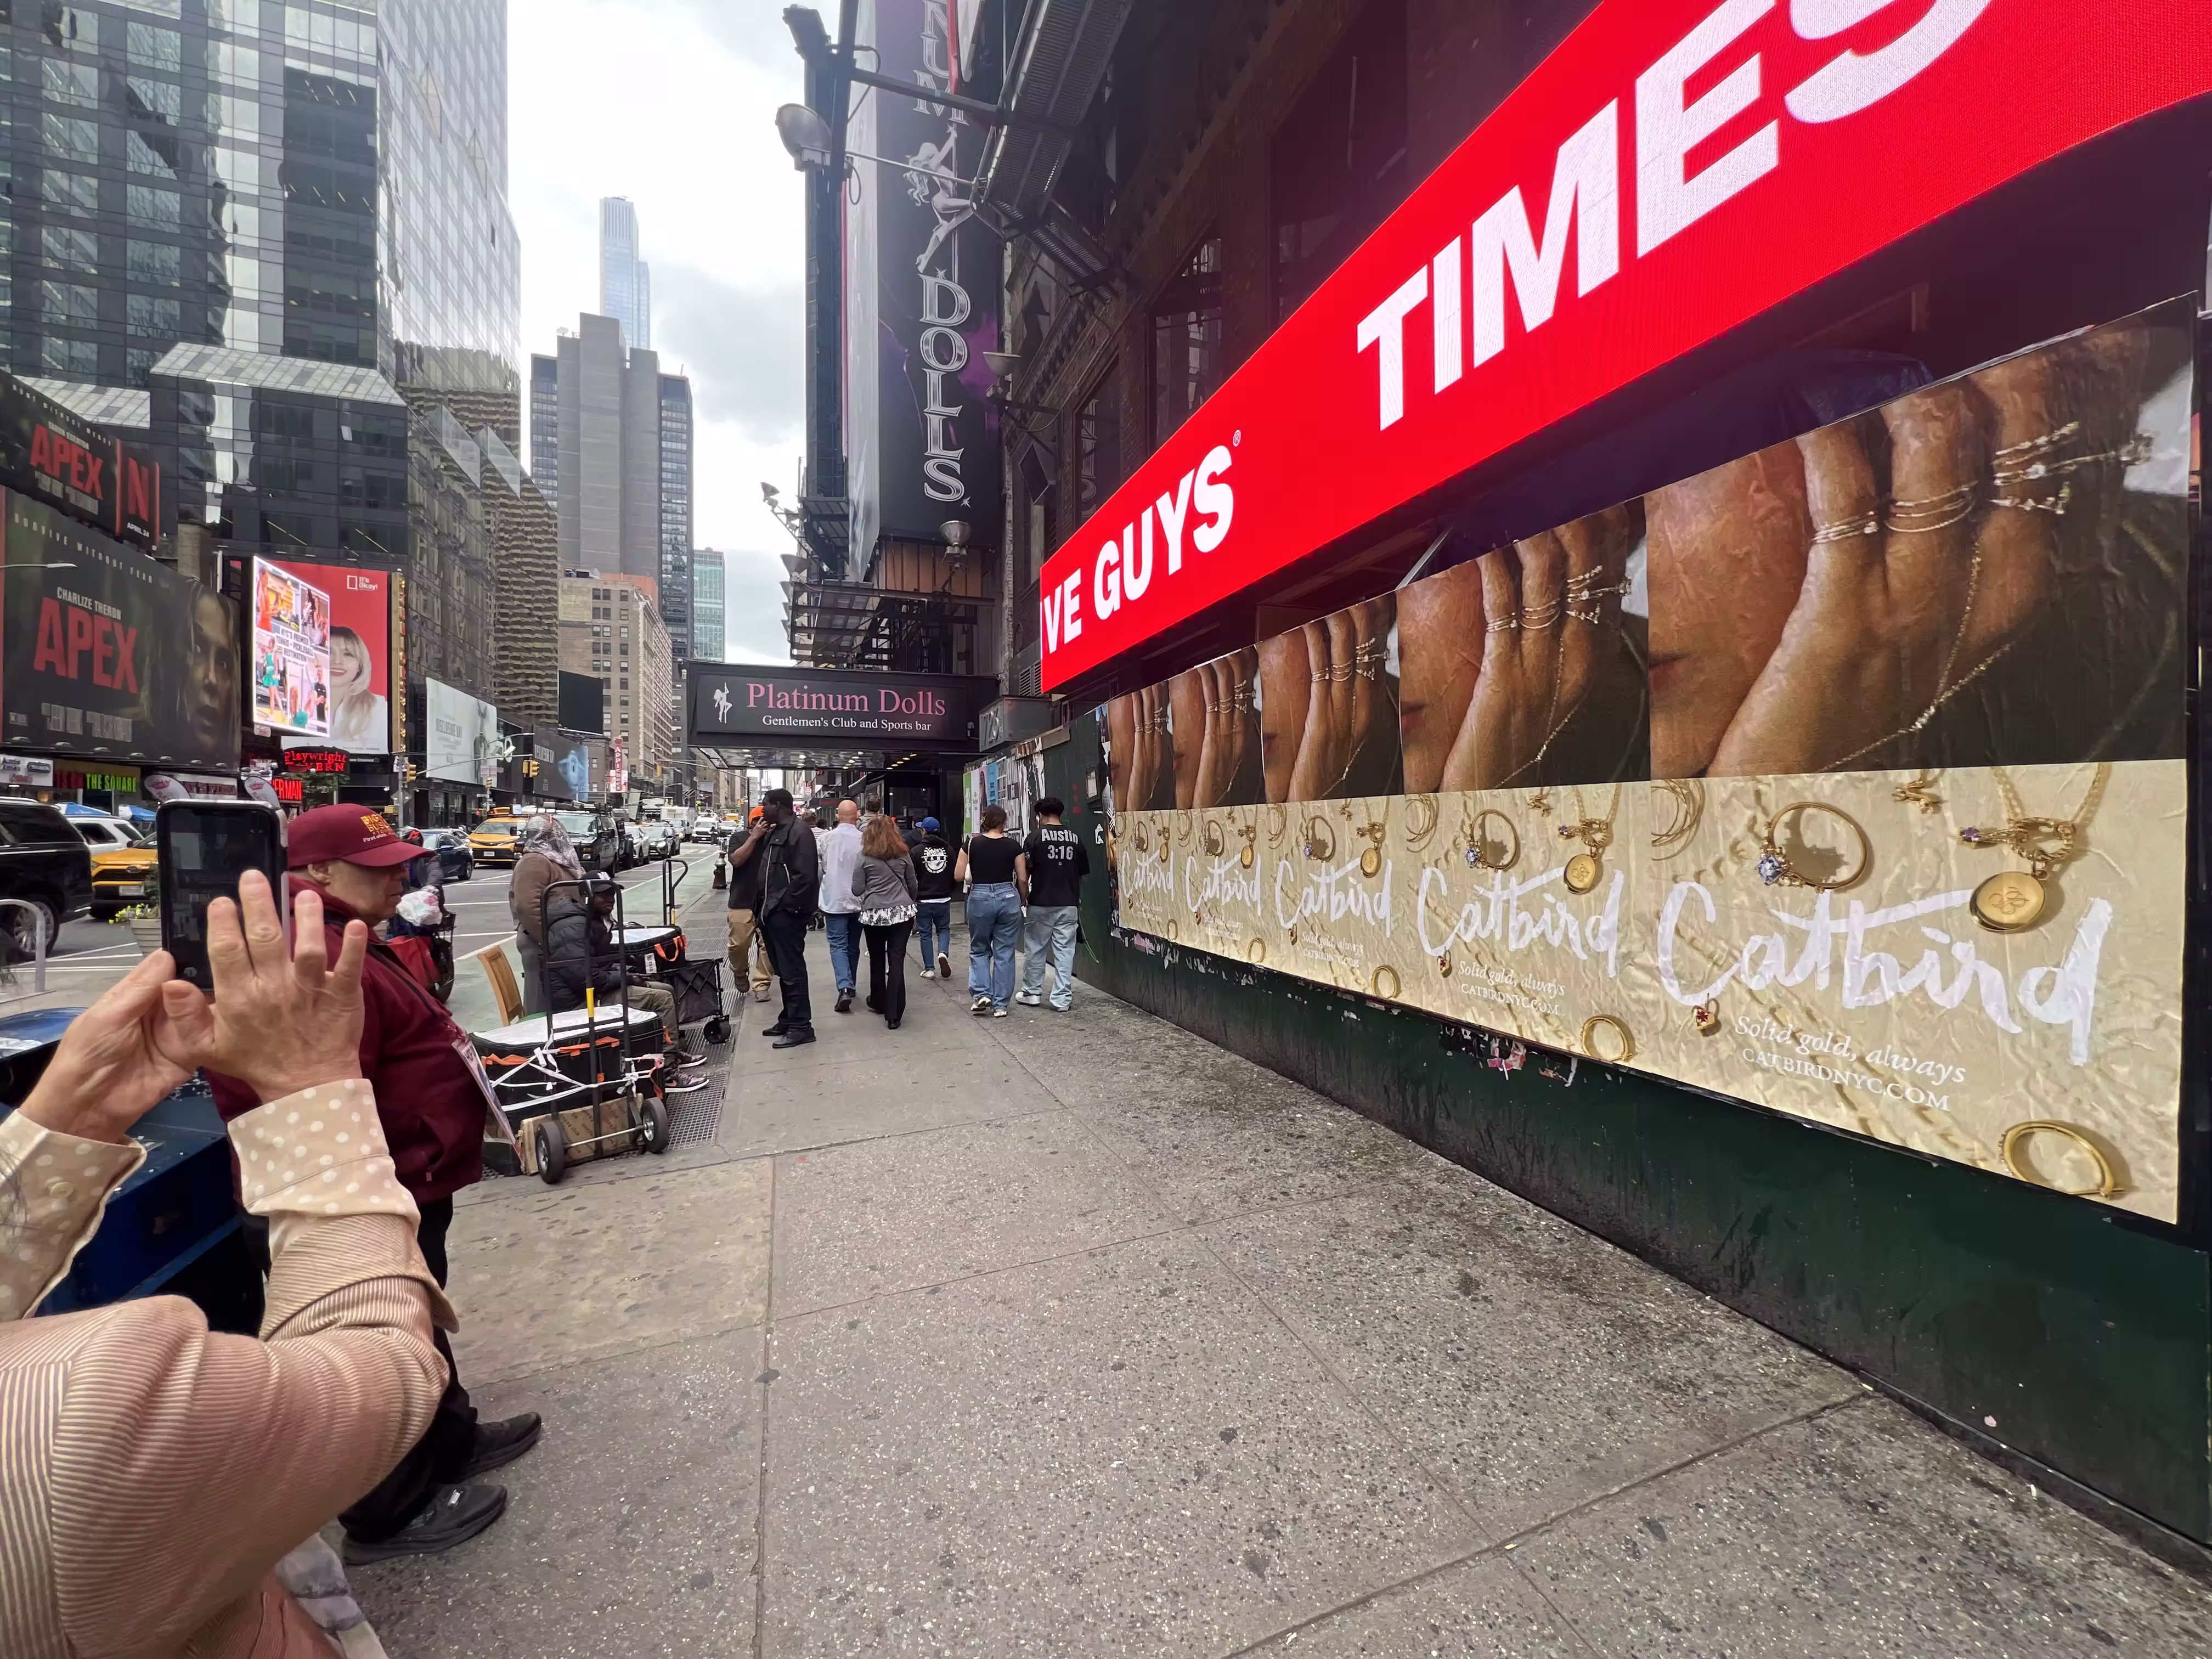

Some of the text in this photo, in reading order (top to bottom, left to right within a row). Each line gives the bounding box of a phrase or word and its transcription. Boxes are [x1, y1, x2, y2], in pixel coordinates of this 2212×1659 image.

[918, 273, 971, 502] DOLLS
[30, 424, 104, 500] APEX
[128, 457, 149, 522] N
[57, 586, 122, 620] CHARLIZE THERON
[1041, 568, 1082, 658] VE
[33, 596, 139, 694] APEX
[746, 683, 946, 716] Platinum Dolls
[762, 715, 932, 732] Gentlemen's Club and Sports bar
[285, 750, 347, 764] Playwright
[86, 774, 102, 789] THE
[104, 774, 137, 793] SQUARE
[272, 778, 302, 799] ERMAN
[360, 814, 380, 825] BIG
[367, 821, 385, 832] BUS
[1041, 828, 1079, 845] Austin
[1047, 844, 1074, 860] 3:16
[1186, 853, 1261, 916] Catbird
[1275, 857, 1393, 938] Catbird
[1418, 866, 1624, 979] Catbird
[1459, 961, 1566, 999] Solid gold, always
[1656, 882, 2114, 1066] Catbird
[1461, 983, 1559, 1015] CATBIRDNYC.COM
[1735, 1015, 1967, 1086] Solid gold, always
[1742, 1048, 1951, 1113] CATBIRDNYC.COM
